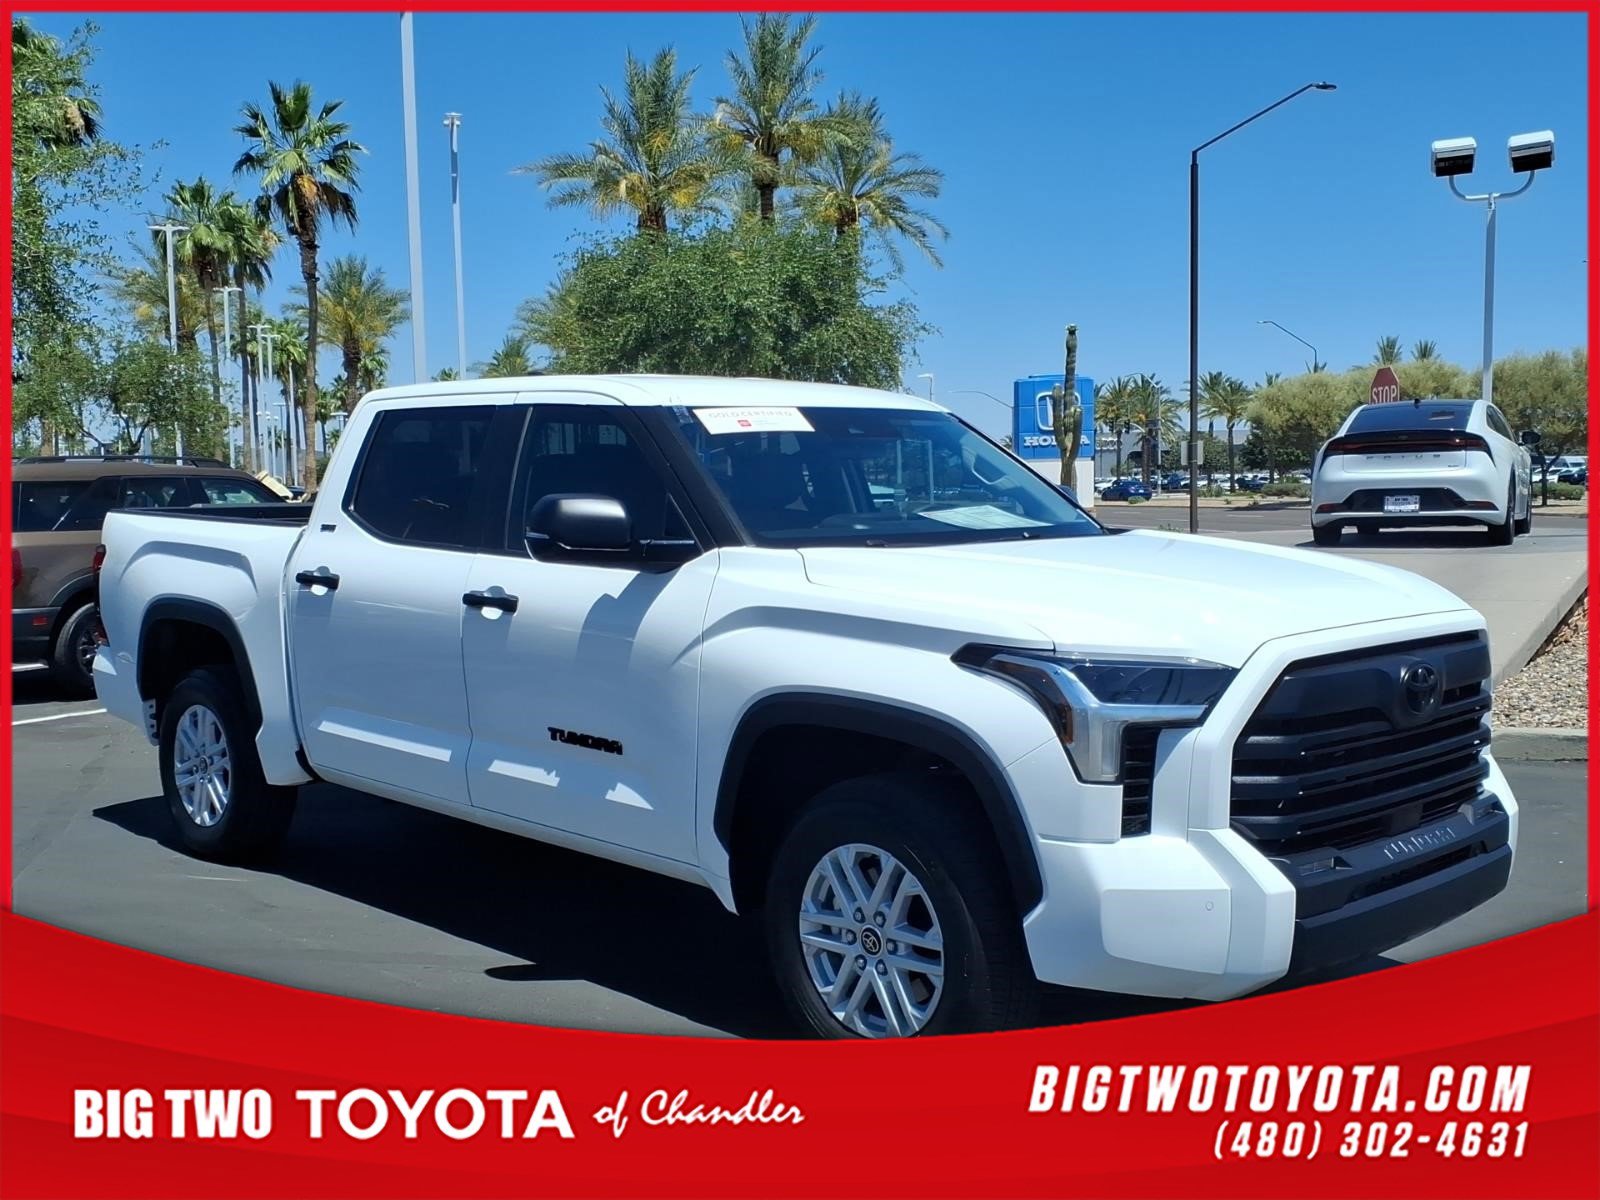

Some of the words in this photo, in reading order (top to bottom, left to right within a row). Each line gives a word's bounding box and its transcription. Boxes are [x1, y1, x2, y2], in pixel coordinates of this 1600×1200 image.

[1372, 385, 1397, 404] STOP
[1023, 435, 1091, 447] HOA
[547, 726, 624, 756] TUNDRA
